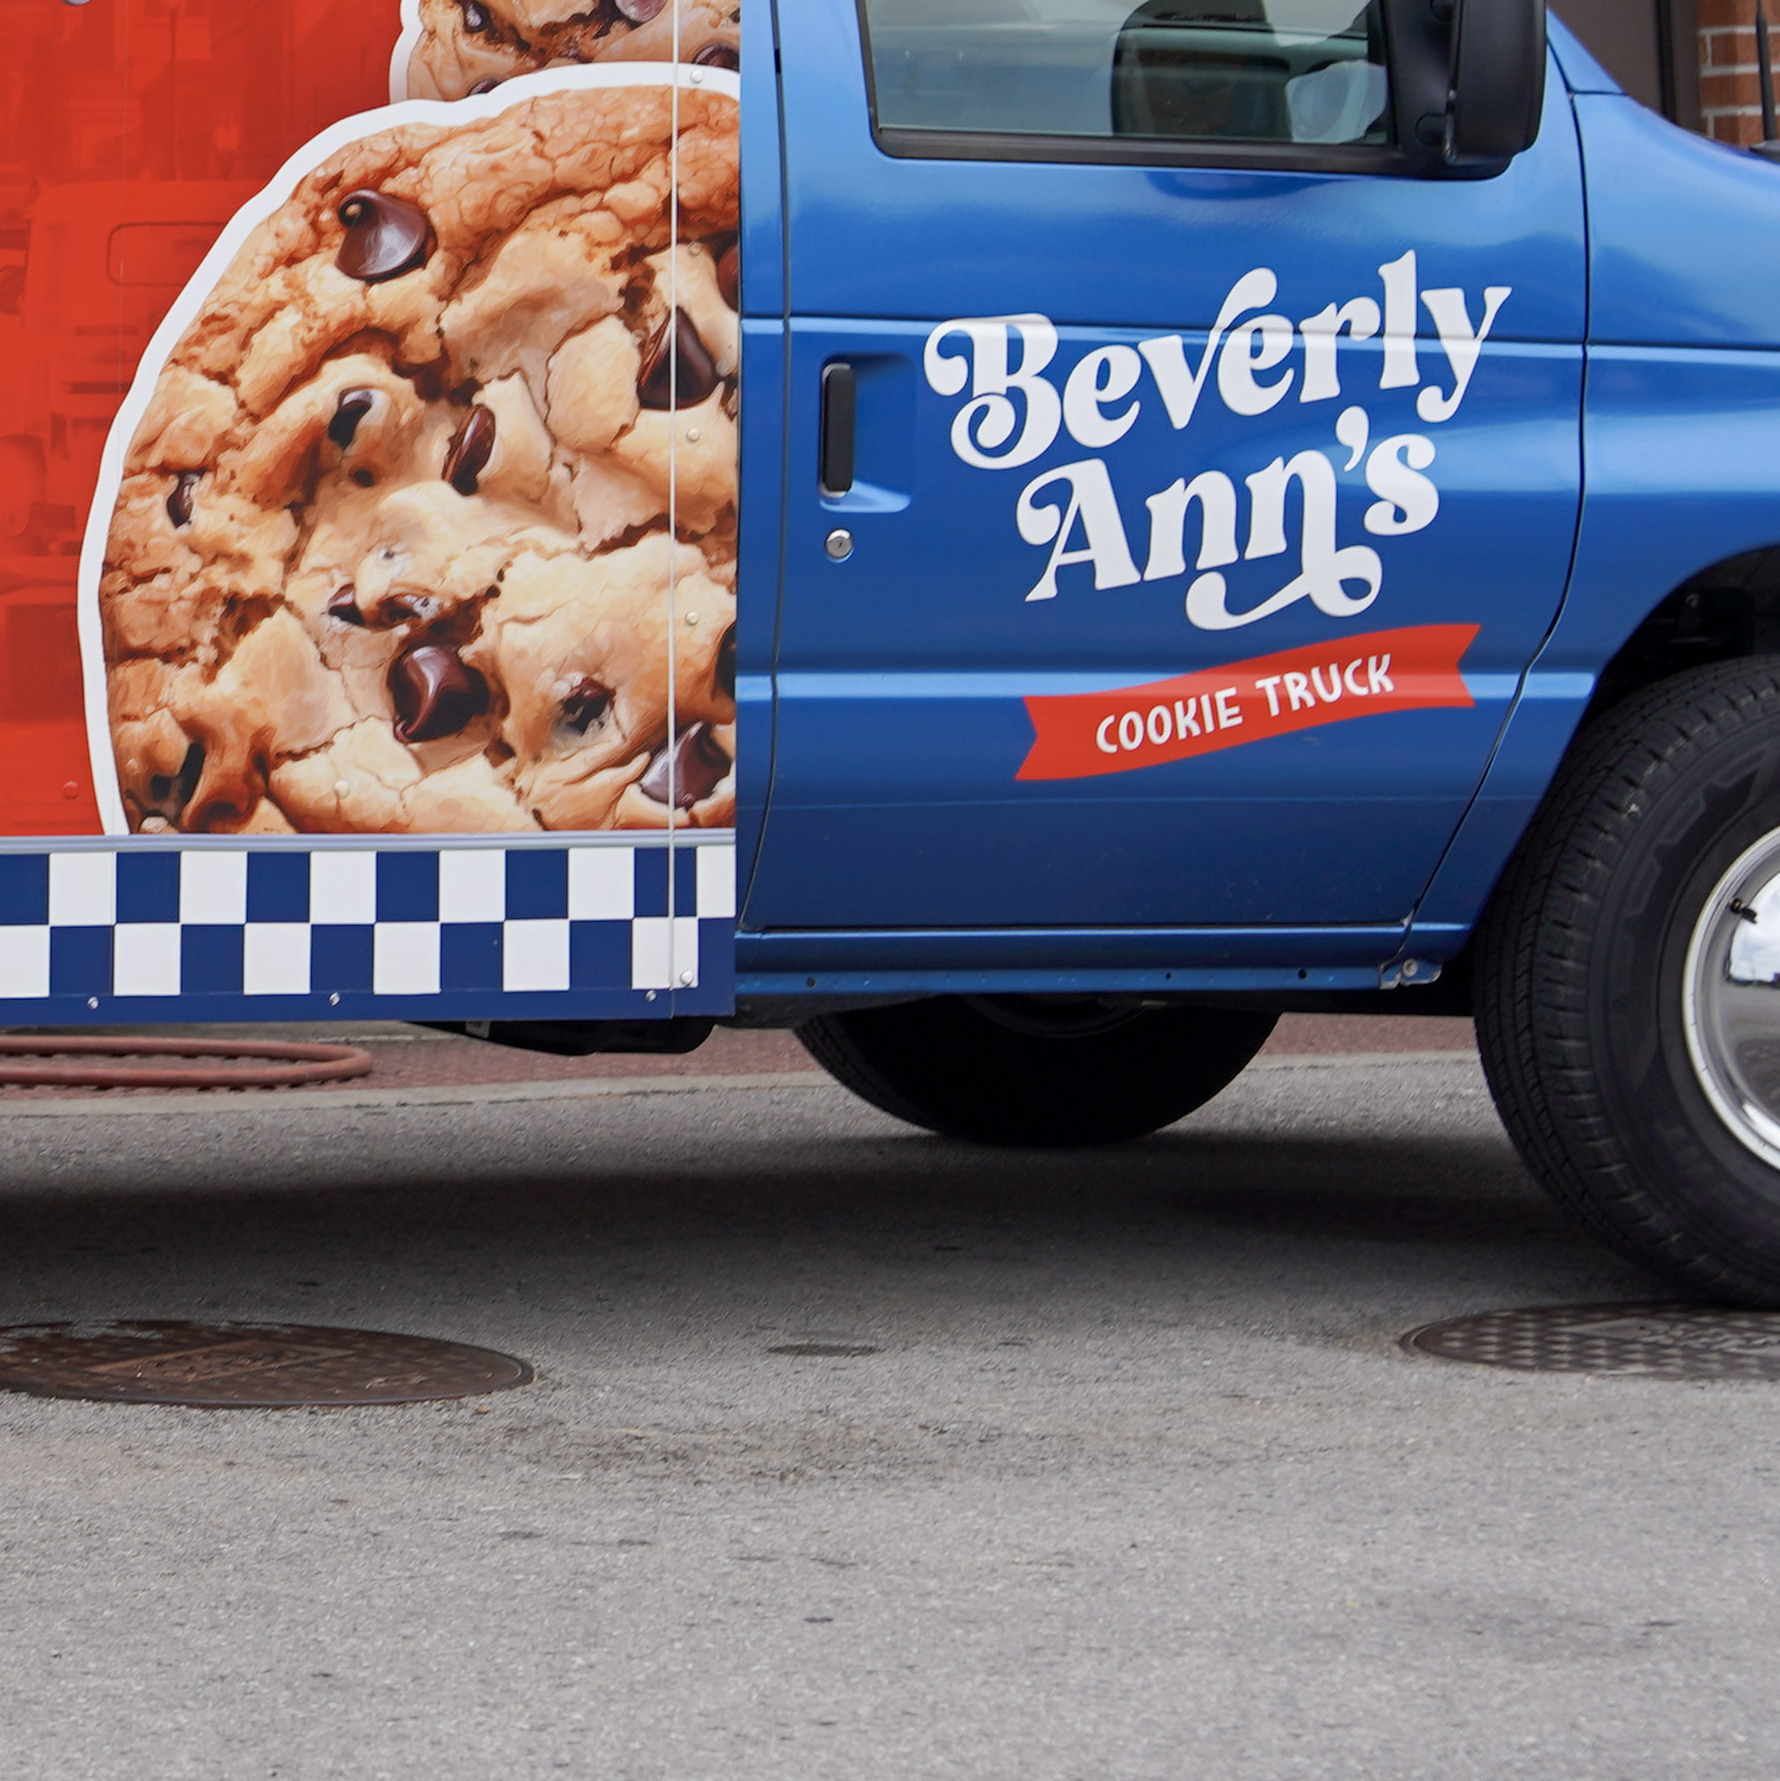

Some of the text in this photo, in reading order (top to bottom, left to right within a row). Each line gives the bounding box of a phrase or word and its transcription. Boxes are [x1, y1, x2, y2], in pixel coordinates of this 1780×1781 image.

[923, 249, 1513, 470] Beverly
[1015, 405, 1440, 631] Ann's
[1095, 653, 1395, 755] COOKIE TRUCK
